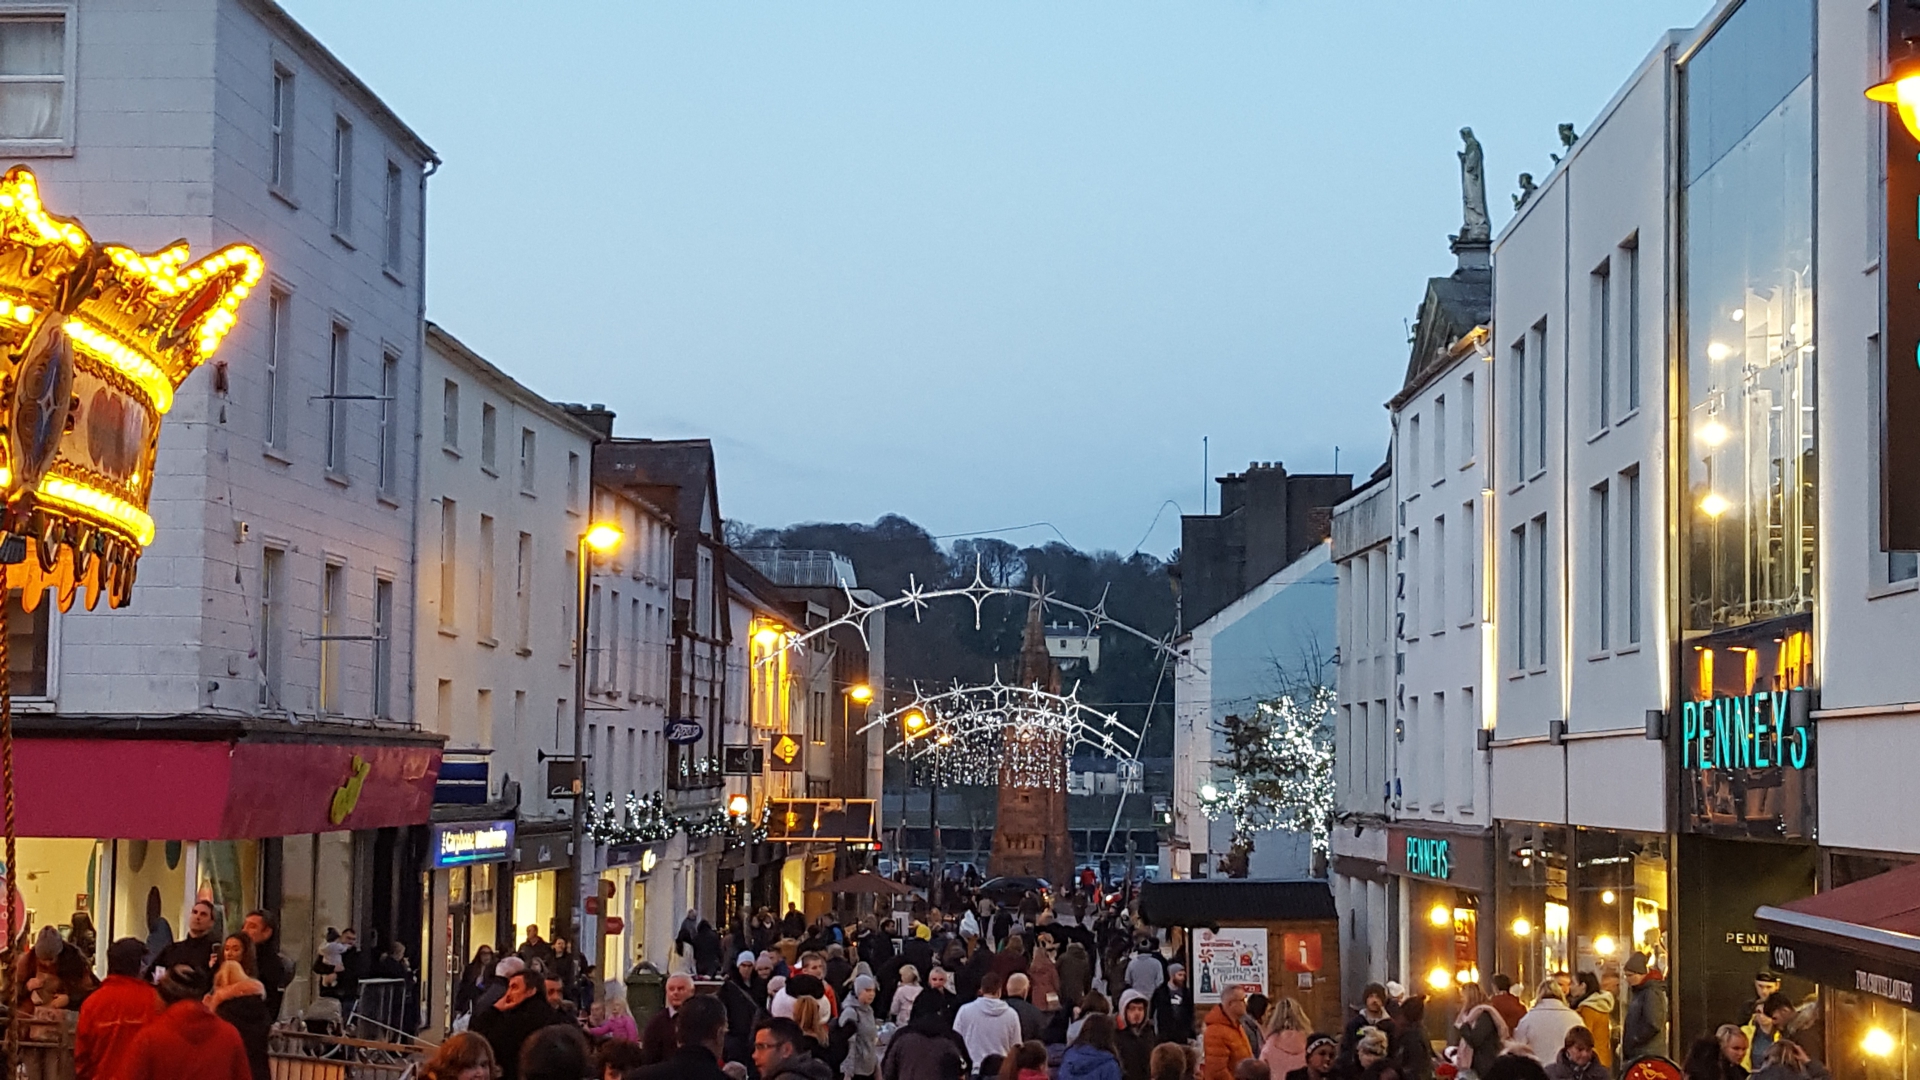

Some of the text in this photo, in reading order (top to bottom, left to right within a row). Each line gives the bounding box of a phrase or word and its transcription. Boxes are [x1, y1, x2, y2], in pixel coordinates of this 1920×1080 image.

[668, 723, 700, 740] Boots
[1683, 687, 1808, 770] PENNEYS
[1406, 836, 1449, 880] PENNEYS
[1774, 946, 1796, 969] COSTA
